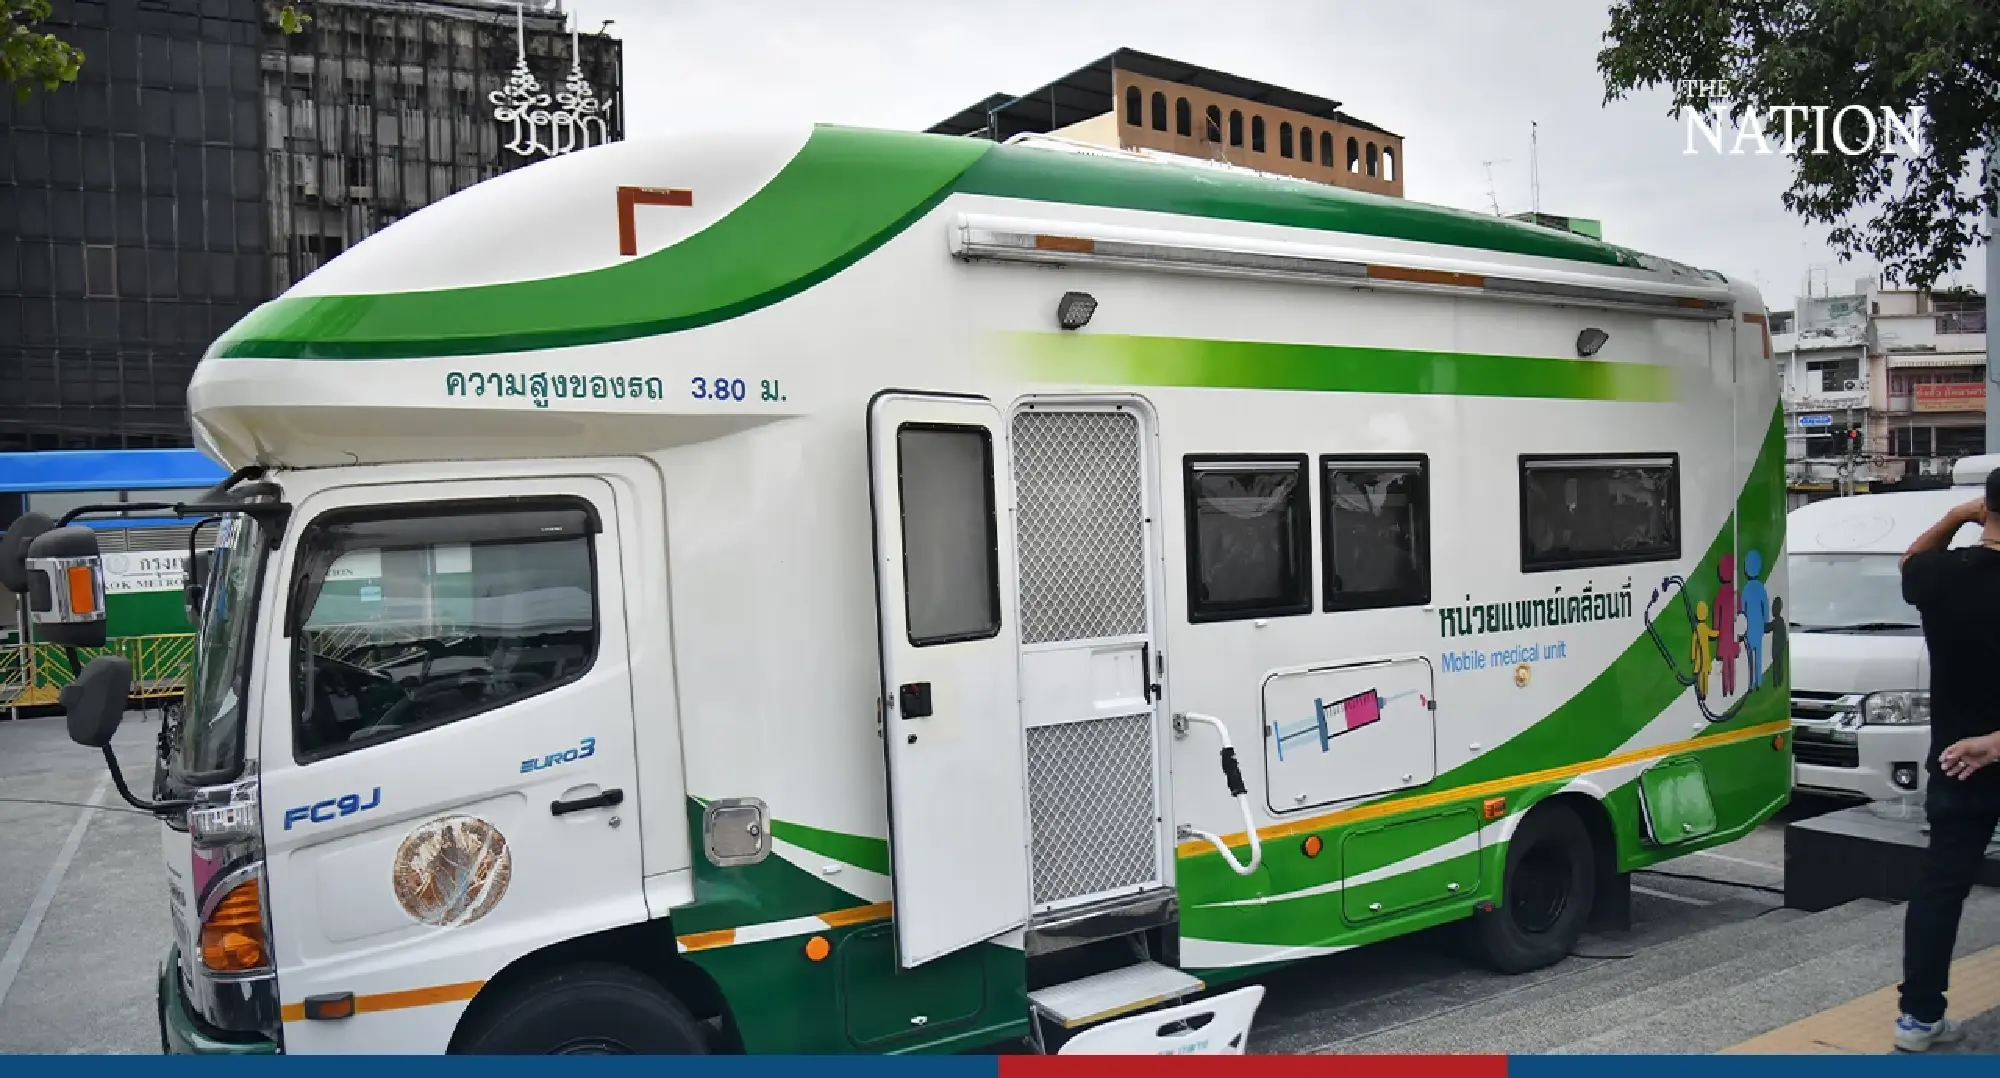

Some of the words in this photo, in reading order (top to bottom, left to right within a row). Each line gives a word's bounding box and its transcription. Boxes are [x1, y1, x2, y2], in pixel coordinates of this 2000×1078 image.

[446, 370, 664, 408] ความสูงของรถ
[691, 376, 746, 401] 3.80
[761, 377, 788, 402] ม.
[1438, 576, 1632, 638] หน่วยแพทย์เคลื่อนที่
[1441, 649, 1487, 673] Mobile
[1490, 642, 1540, 667] medical
[1543, 640, 1567, 660] unit
[283, 786, 381, 831] FC9J
